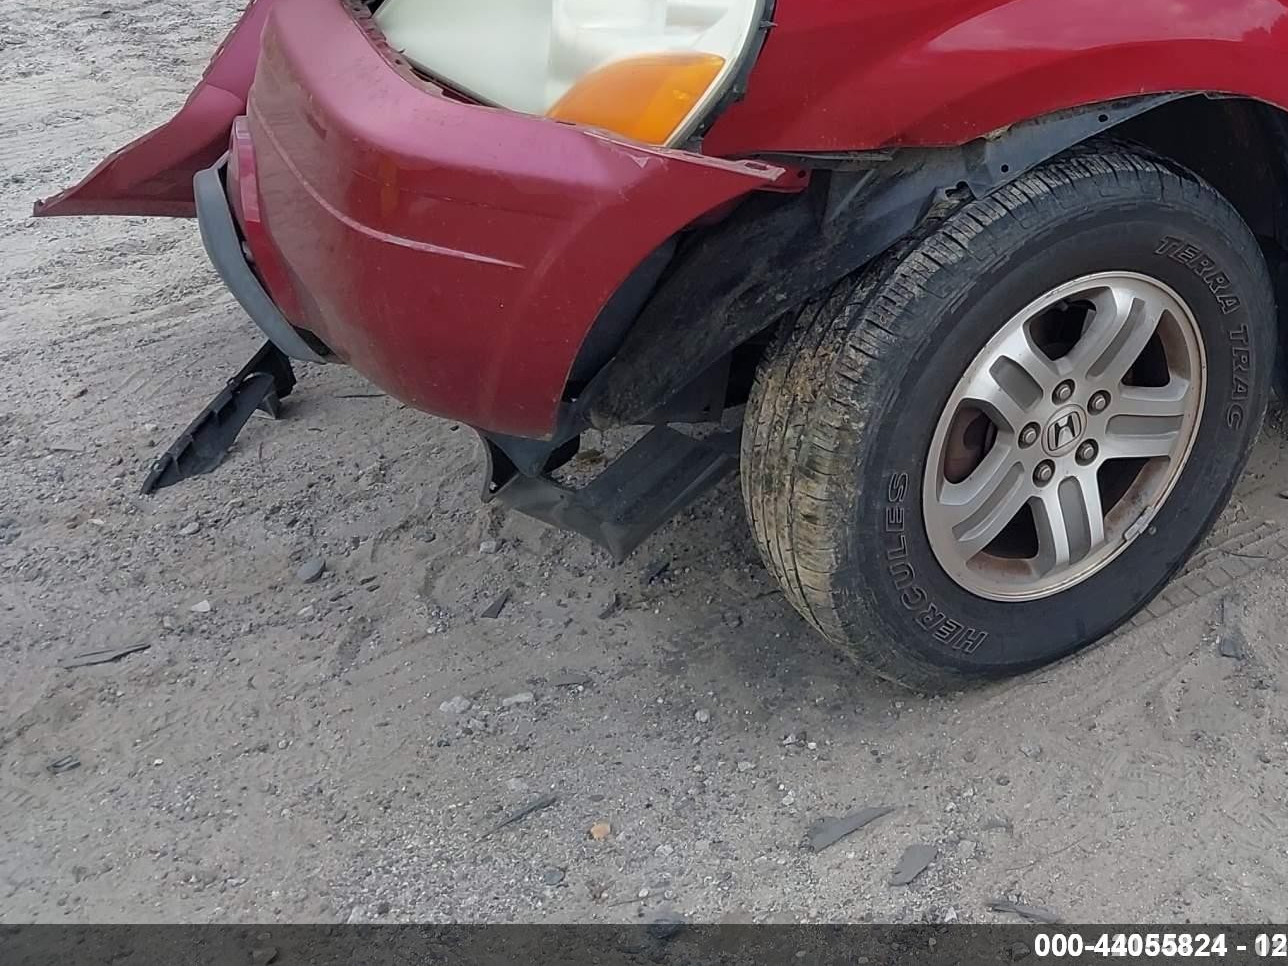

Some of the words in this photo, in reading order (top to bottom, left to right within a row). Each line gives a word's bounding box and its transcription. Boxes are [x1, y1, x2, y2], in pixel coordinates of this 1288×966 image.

[1154, 235, 1241, 315] TERRA
[1226, 324, 1250, 430] TRAC
[886, 472, 989, 654] HERCULES
